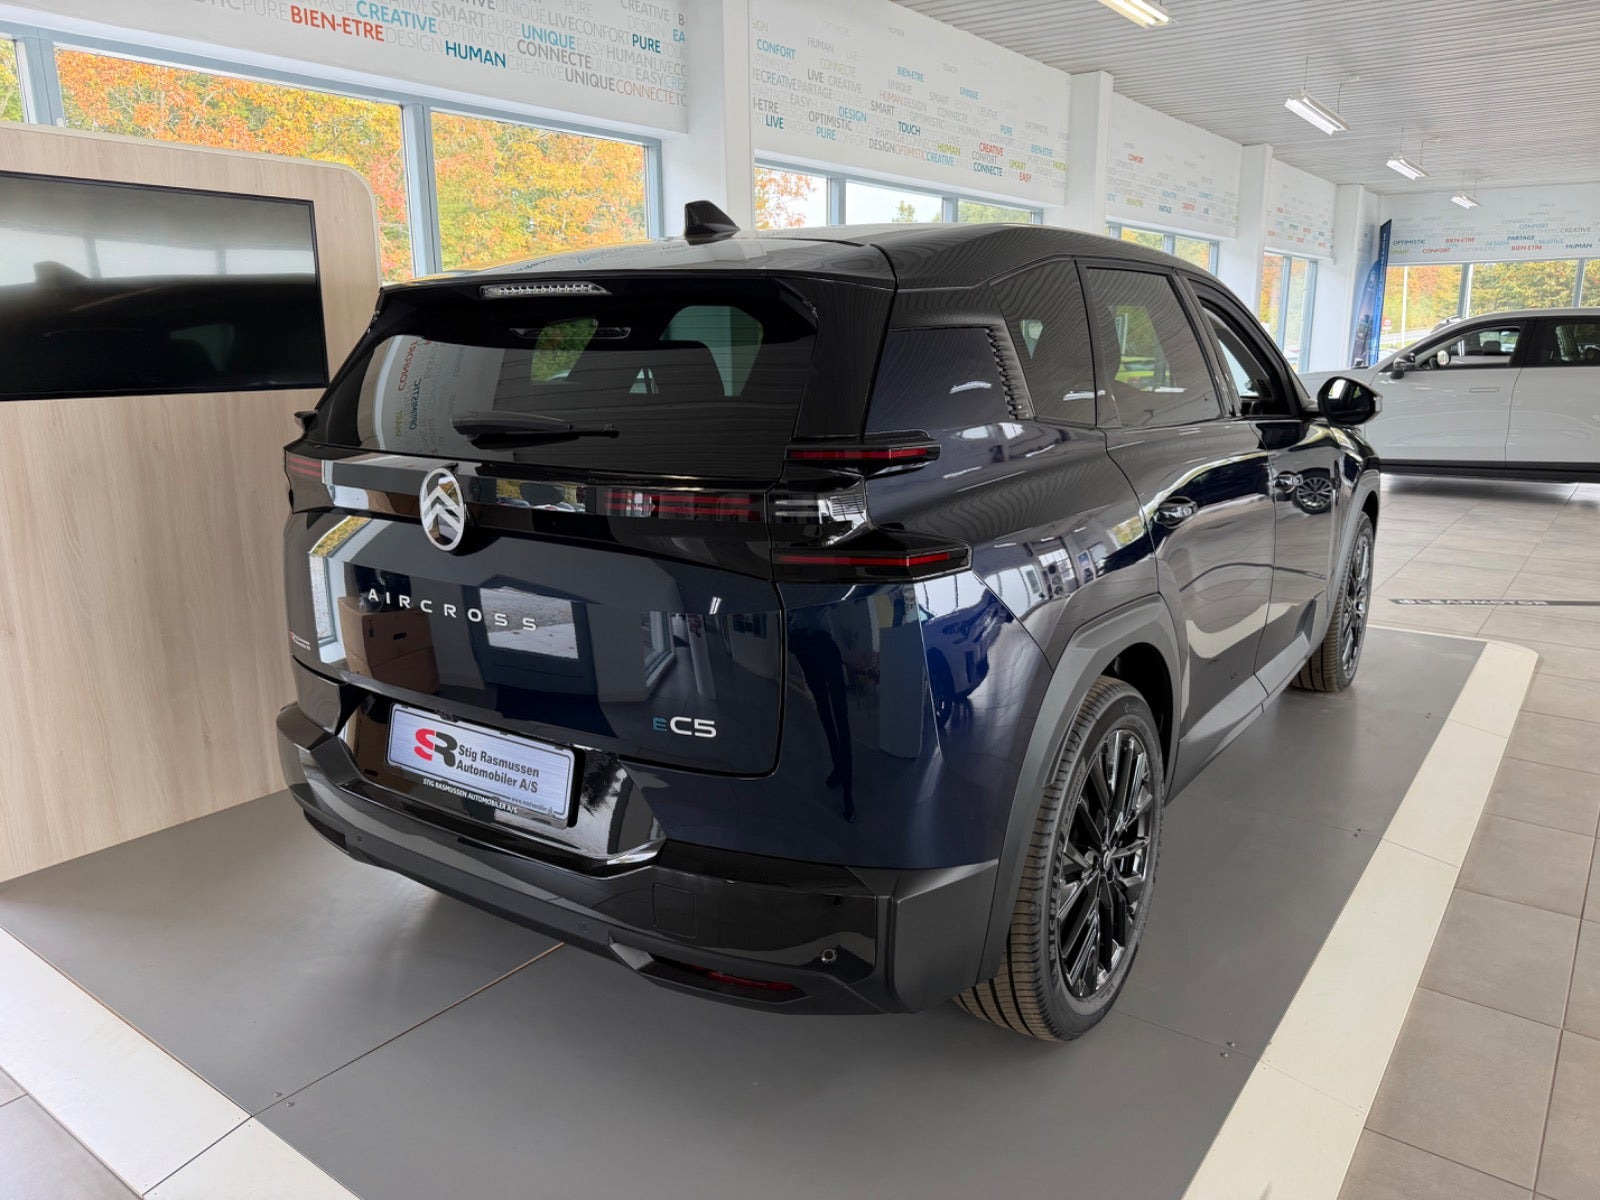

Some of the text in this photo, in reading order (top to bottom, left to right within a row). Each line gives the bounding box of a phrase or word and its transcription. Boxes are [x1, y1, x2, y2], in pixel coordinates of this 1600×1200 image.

[620, 0, 670, 22] CREATIVE
[430, 0, 486, 28] SMART
[487, 14, 521, 37] PURE
[521, 23, 576, 51] UNIQUE
[606, 45, 653, 70] HUMAN
[547, 10, 575, 32] LIVE
[575, 17, 630, 44] CONFORT
[632, 33, 661, 54] PURE
[355, 1, 437, 34] CREATIVE
[438, 20, 516, 53] OPTIMISTIC
[517, 39, 592, 69] CONNECTE
[635, 68, 664, 87] EASY
[756, 38, 796, 60] CONFORT
[807, 36, 834, 53] HUMAN
[290, 5, 385, 42] BIEN-ETRE
[385, 26, 443, 54] DESIGN
[445, 39, 506, 68] HUMAN
[507, 54, 565, 82] CREATIVE
[565, 67, 615, 91] UNIQUE
[616, 79, 675, 105] CONNECTE
[807, 68, 863, 95] LIVE CREATIVE
[896, 66, 924, 83] BIEN-ETRE
[760, 70, 797, 91] CREATIVE
[797, 79, 833, 100] PARTAGE
[888, 79, 912, 95] UNIQUE
[959, 86, 979, 100] UNIQUE
[789, 93, 811, 108] EASY
[879, 90, 903, 106] HUMAN
[838, 106, 867, 123] DESIGN
[870, 100, 895, 116] SMART
[937, 106, 968, 124] CONNECTE
[765, 113, 785, 130] LIVE
[808, 110, 853, 132] OPTIMISTIC
[909, 110, 945, 130] OPTIMISTIC
[816, 126, 837, 141] PURE
[897, 121, 921, 137] TOUCH
[868, 138, 895, 154] DESIGN
[895, 143, 926, 161] OPTIMISTIC
[926, 151, 954, 167] CREATIVE
[937, 143, 961, 156] HUMAN
[971, 150, 997, 165] CONFORT
[979, 142, 1004, 157] CREATIVE
[973, 162, 1003, 177] CONNECTE
[1019, 171, 1032, 183] EASY
[368, 588, 536, 632] AIRCROSS
[458, 744, 540, 778] Stig Rasmussen
[455, 759, 538, 794] Automobiler A/S
[422, 777, 435, 787] STIG
[435, 781, 467, 799] RASMUSSEN
[467, 792, 506, 811] AUTOMOBILER
[506, 804, 518, 814] A/S
